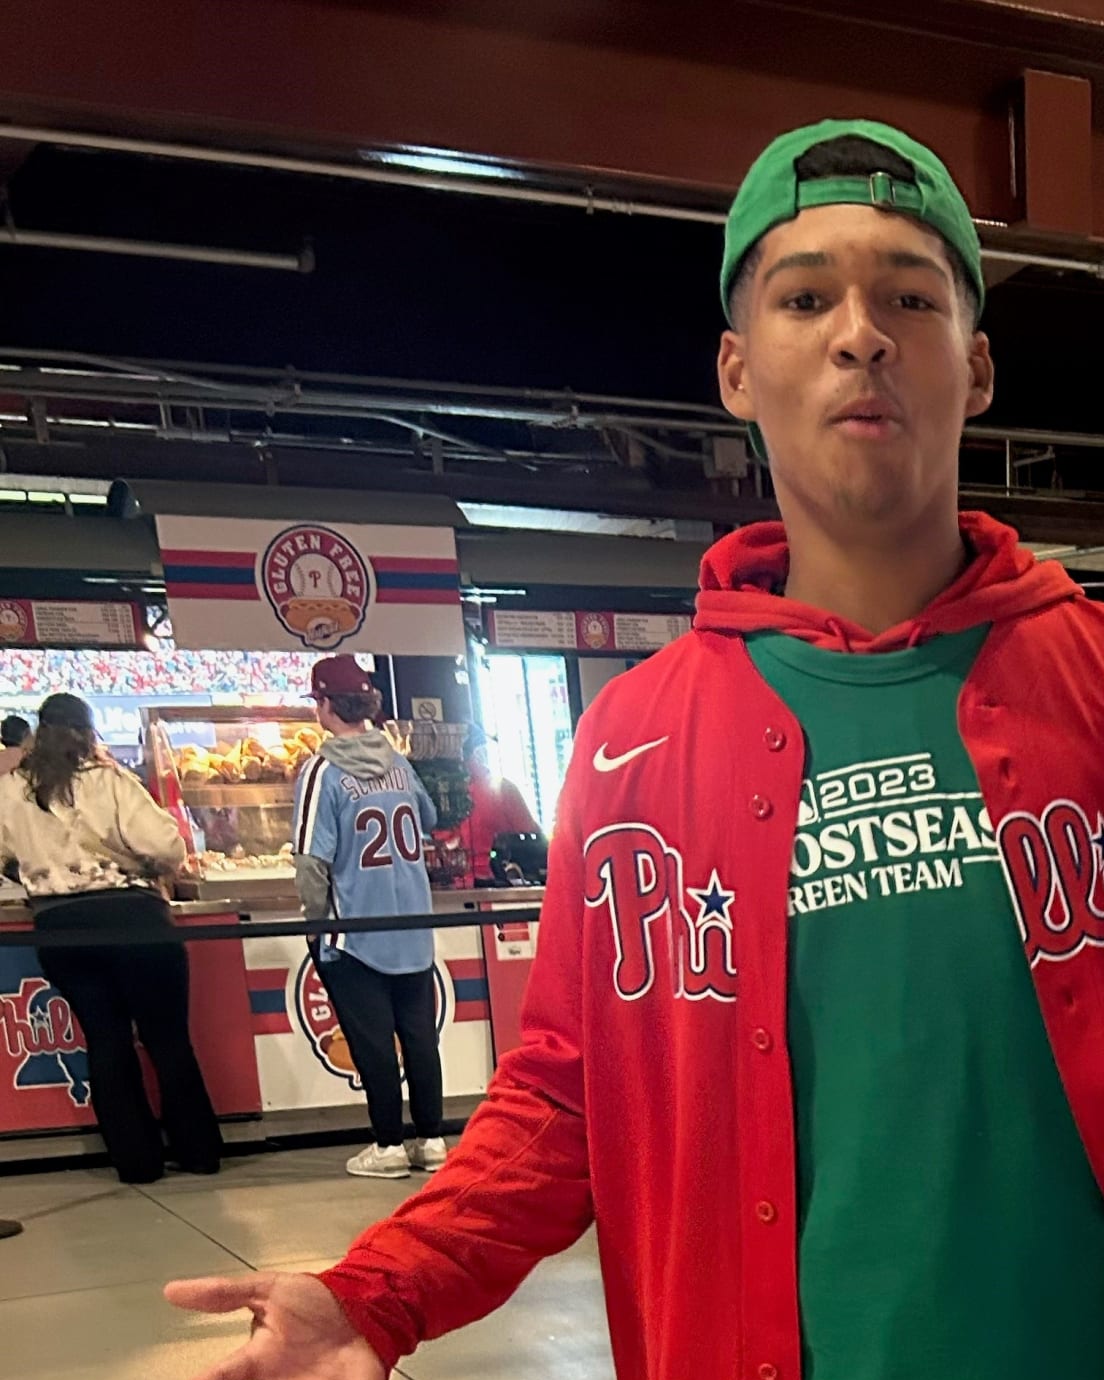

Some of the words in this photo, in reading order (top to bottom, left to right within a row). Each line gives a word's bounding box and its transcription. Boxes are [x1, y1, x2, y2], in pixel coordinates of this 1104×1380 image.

[271, 534, 321, 594] GLUTEN
[328, 543, 362, 597] FREE
[819, 764, 936, 810] 2023
[355, 802, 421, 871] 20
[790, 806, 999, 878] OSTSEAS
[787, 869, 868, 917] REEN
[871, 858, 964, 897] TEAM
